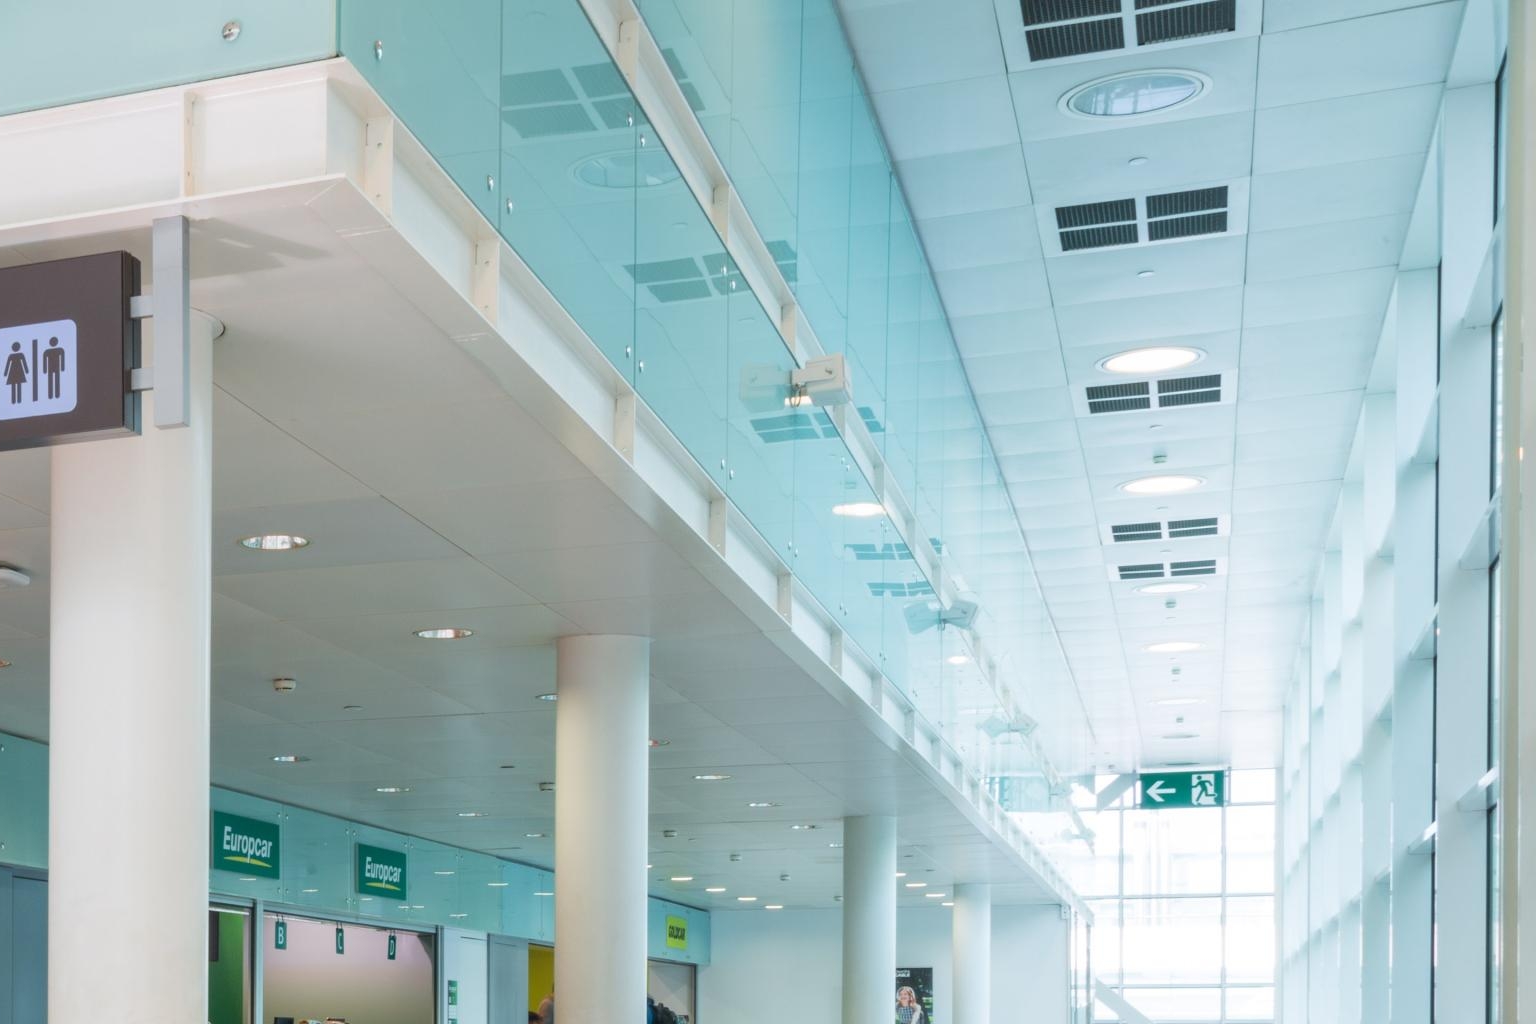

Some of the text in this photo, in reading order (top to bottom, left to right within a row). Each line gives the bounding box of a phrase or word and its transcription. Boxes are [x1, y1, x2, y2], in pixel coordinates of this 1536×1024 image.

[223, 825, 273, 864] Europcar
[365, 857, 402, 888] Europcar
[278, 926, 285, 945] B
[337, 932, 343, 950] C
[389, 940, 395, 956] D
